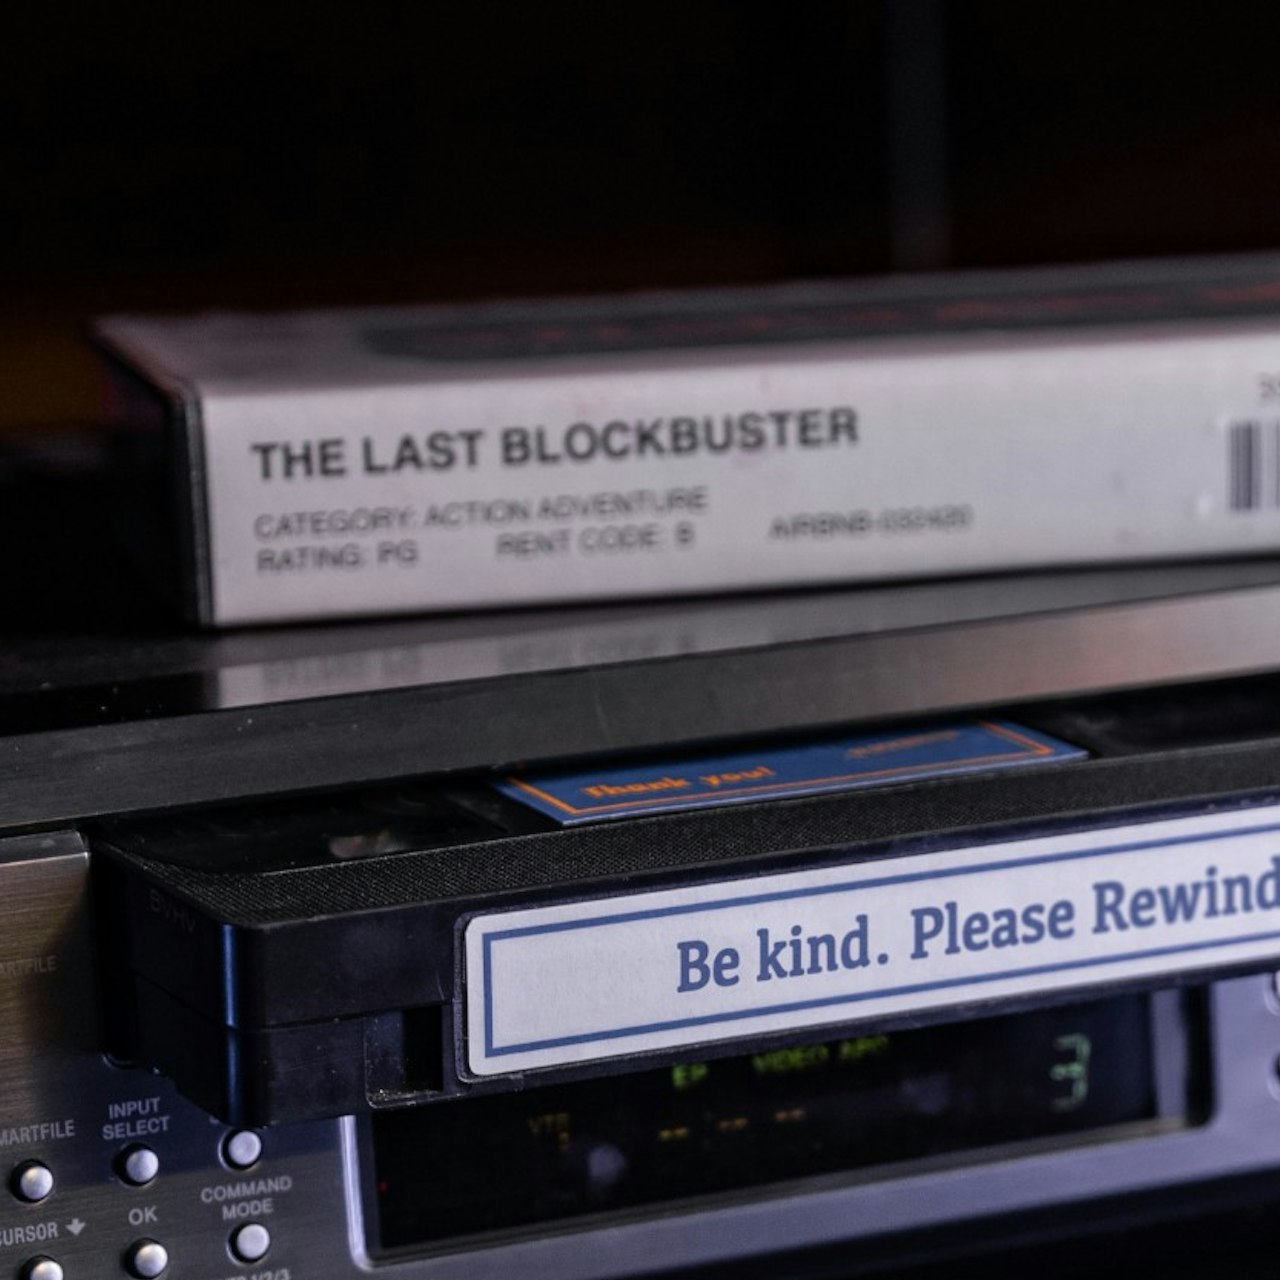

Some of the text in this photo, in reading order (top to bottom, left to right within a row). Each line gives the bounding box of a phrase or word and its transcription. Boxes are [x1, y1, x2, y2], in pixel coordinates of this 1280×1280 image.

[252, 408, 859, 478] THE LAST BLOCKBUSTER
[424, 498, 532, 530] ACTION
[536, 486, 710, 522] ADVENTURE
[377, 541, 419, 565] PG
[496, 532, 570, 560] RENT
[582, 766, 775, 797] Thank you!
[676, 939, 740, 993] Be
[757, 914, 887, 978] kind.
[910, 895, 1074, 958] Please
[109, 1098, 160, 1119] INPUT
[102, 1116, 169, 1140] SELECT
[201, 1176, 293, 1203] COMMAND
[128, 1206, 158, 1225] OK
[222, 1199, 274, 1220] MODE
